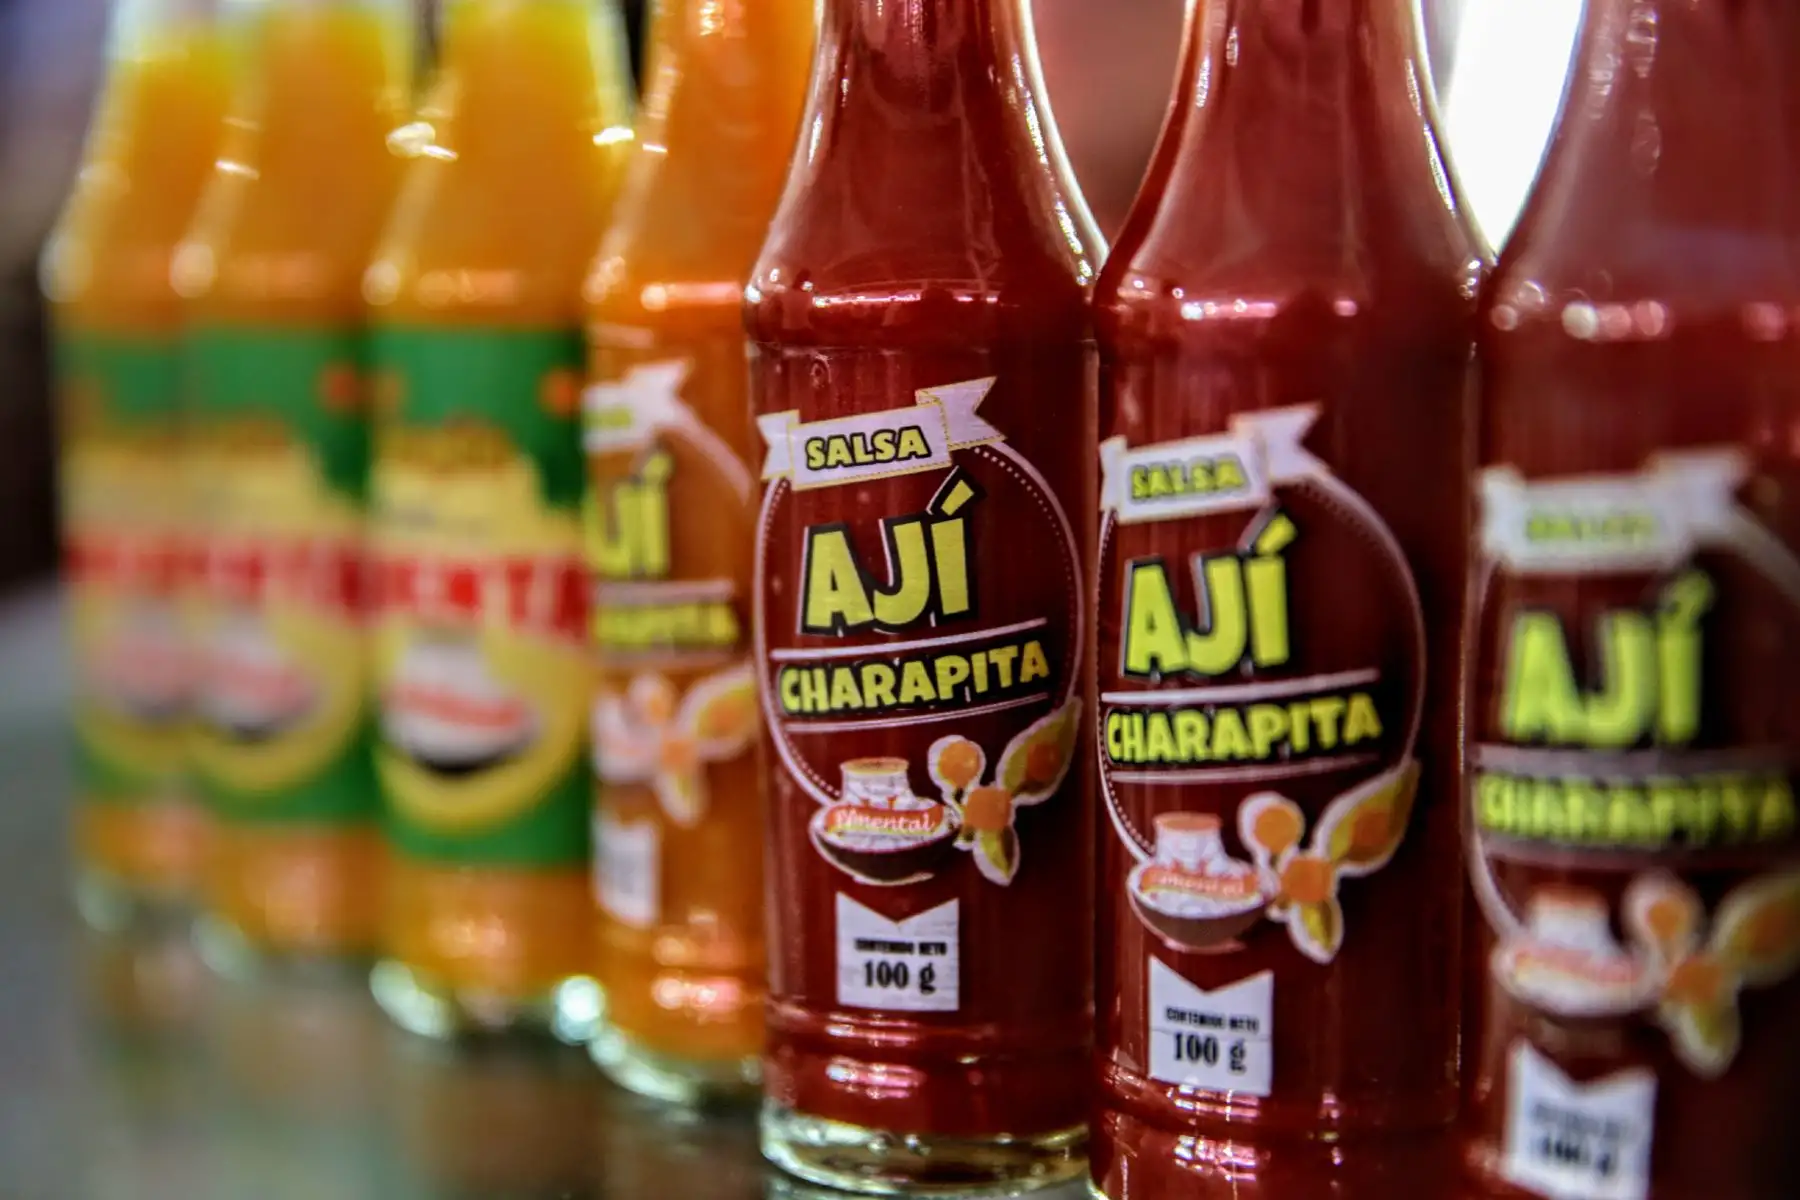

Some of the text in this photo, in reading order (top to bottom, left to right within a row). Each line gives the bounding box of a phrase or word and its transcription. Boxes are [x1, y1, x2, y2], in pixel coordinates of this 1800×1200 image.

[806, 426, 931, 470] SALSA
[1131, 457, 1245, 500] SALSA
[804, 478, 974, 629] AJÍ
[1126, 512, 1297, 676] AJÍ
[780, 640, 1050, 713] CHARAPITA
[1505, 570, 1714, 747] AJÍ
[1106, 693, 1383, 763] CHARAPITA
[864, 960, 936, 995] 100 g
[1174, 1031, 1247, 1074] 100 g
